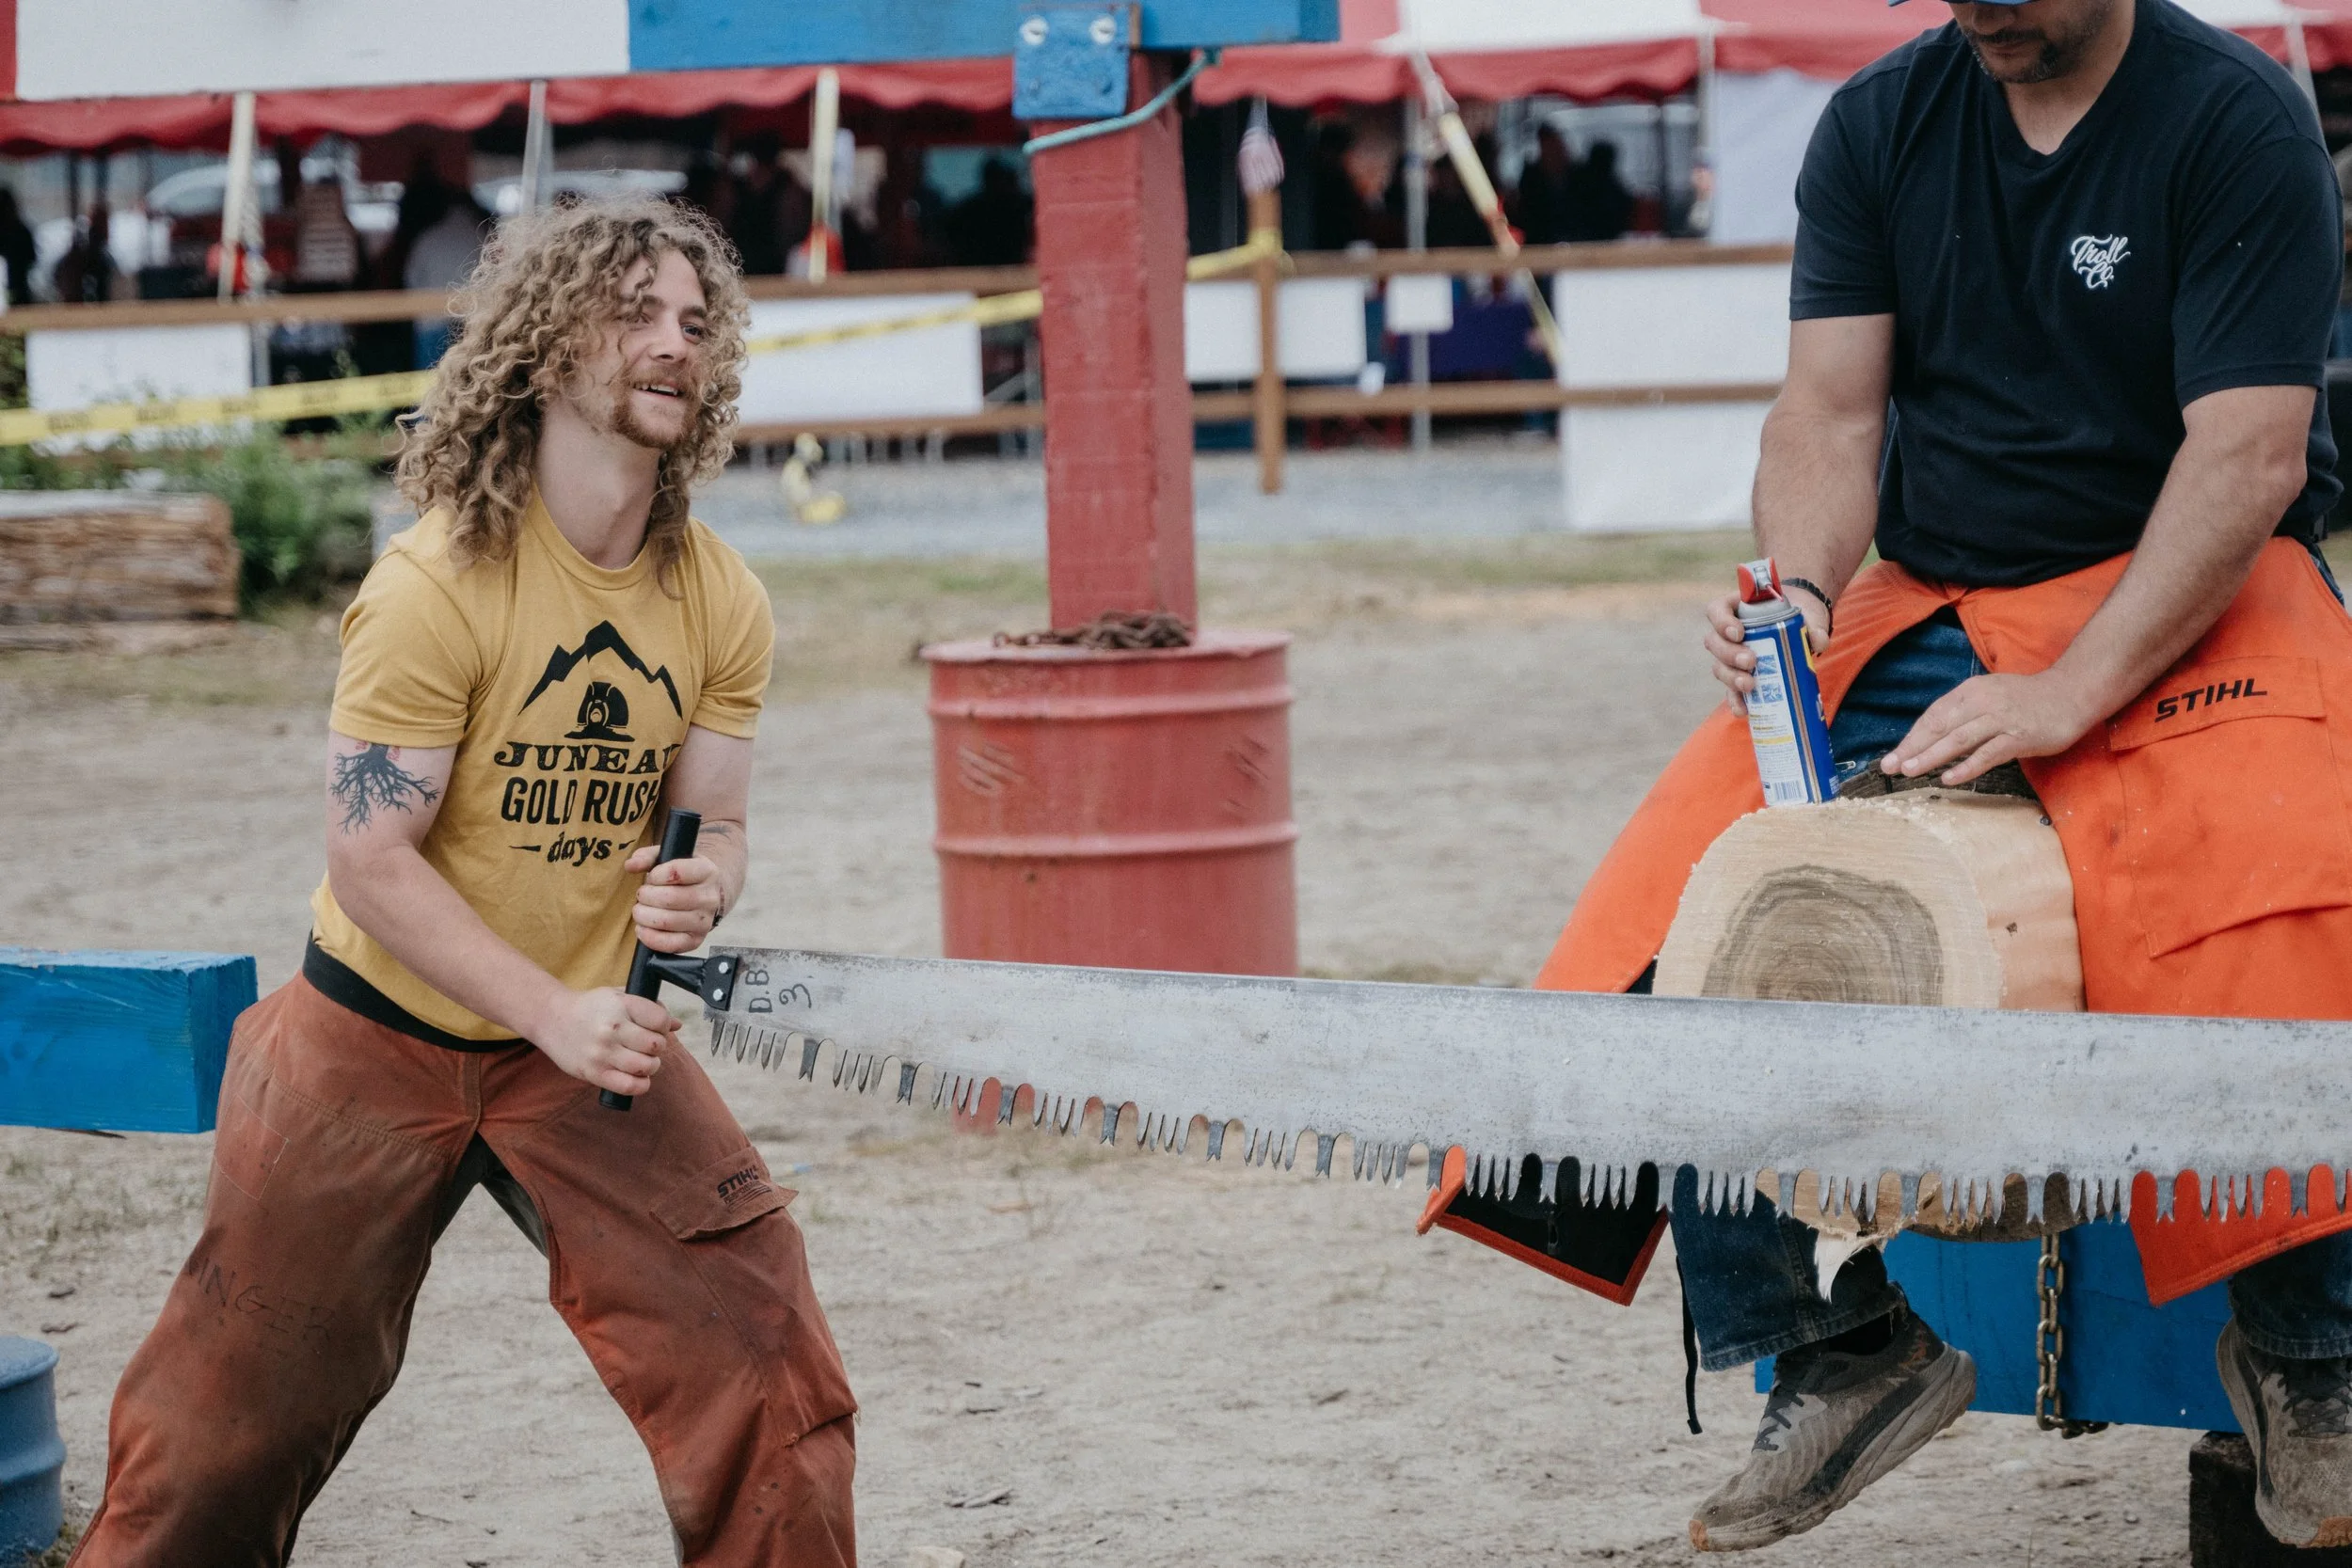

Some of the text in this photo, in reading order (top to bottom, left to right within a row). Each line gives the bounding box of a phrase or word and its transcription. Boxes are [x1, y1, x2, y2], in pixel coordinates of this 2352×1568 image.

[2071, 233, 2131, 272] Troll
[2154, 678, 2267, 722] STIHL
[501, 776, 660, 826] GOLD RUSH
[547, 831, 612, 866] days
[779, 983, 812, 1009] 3
